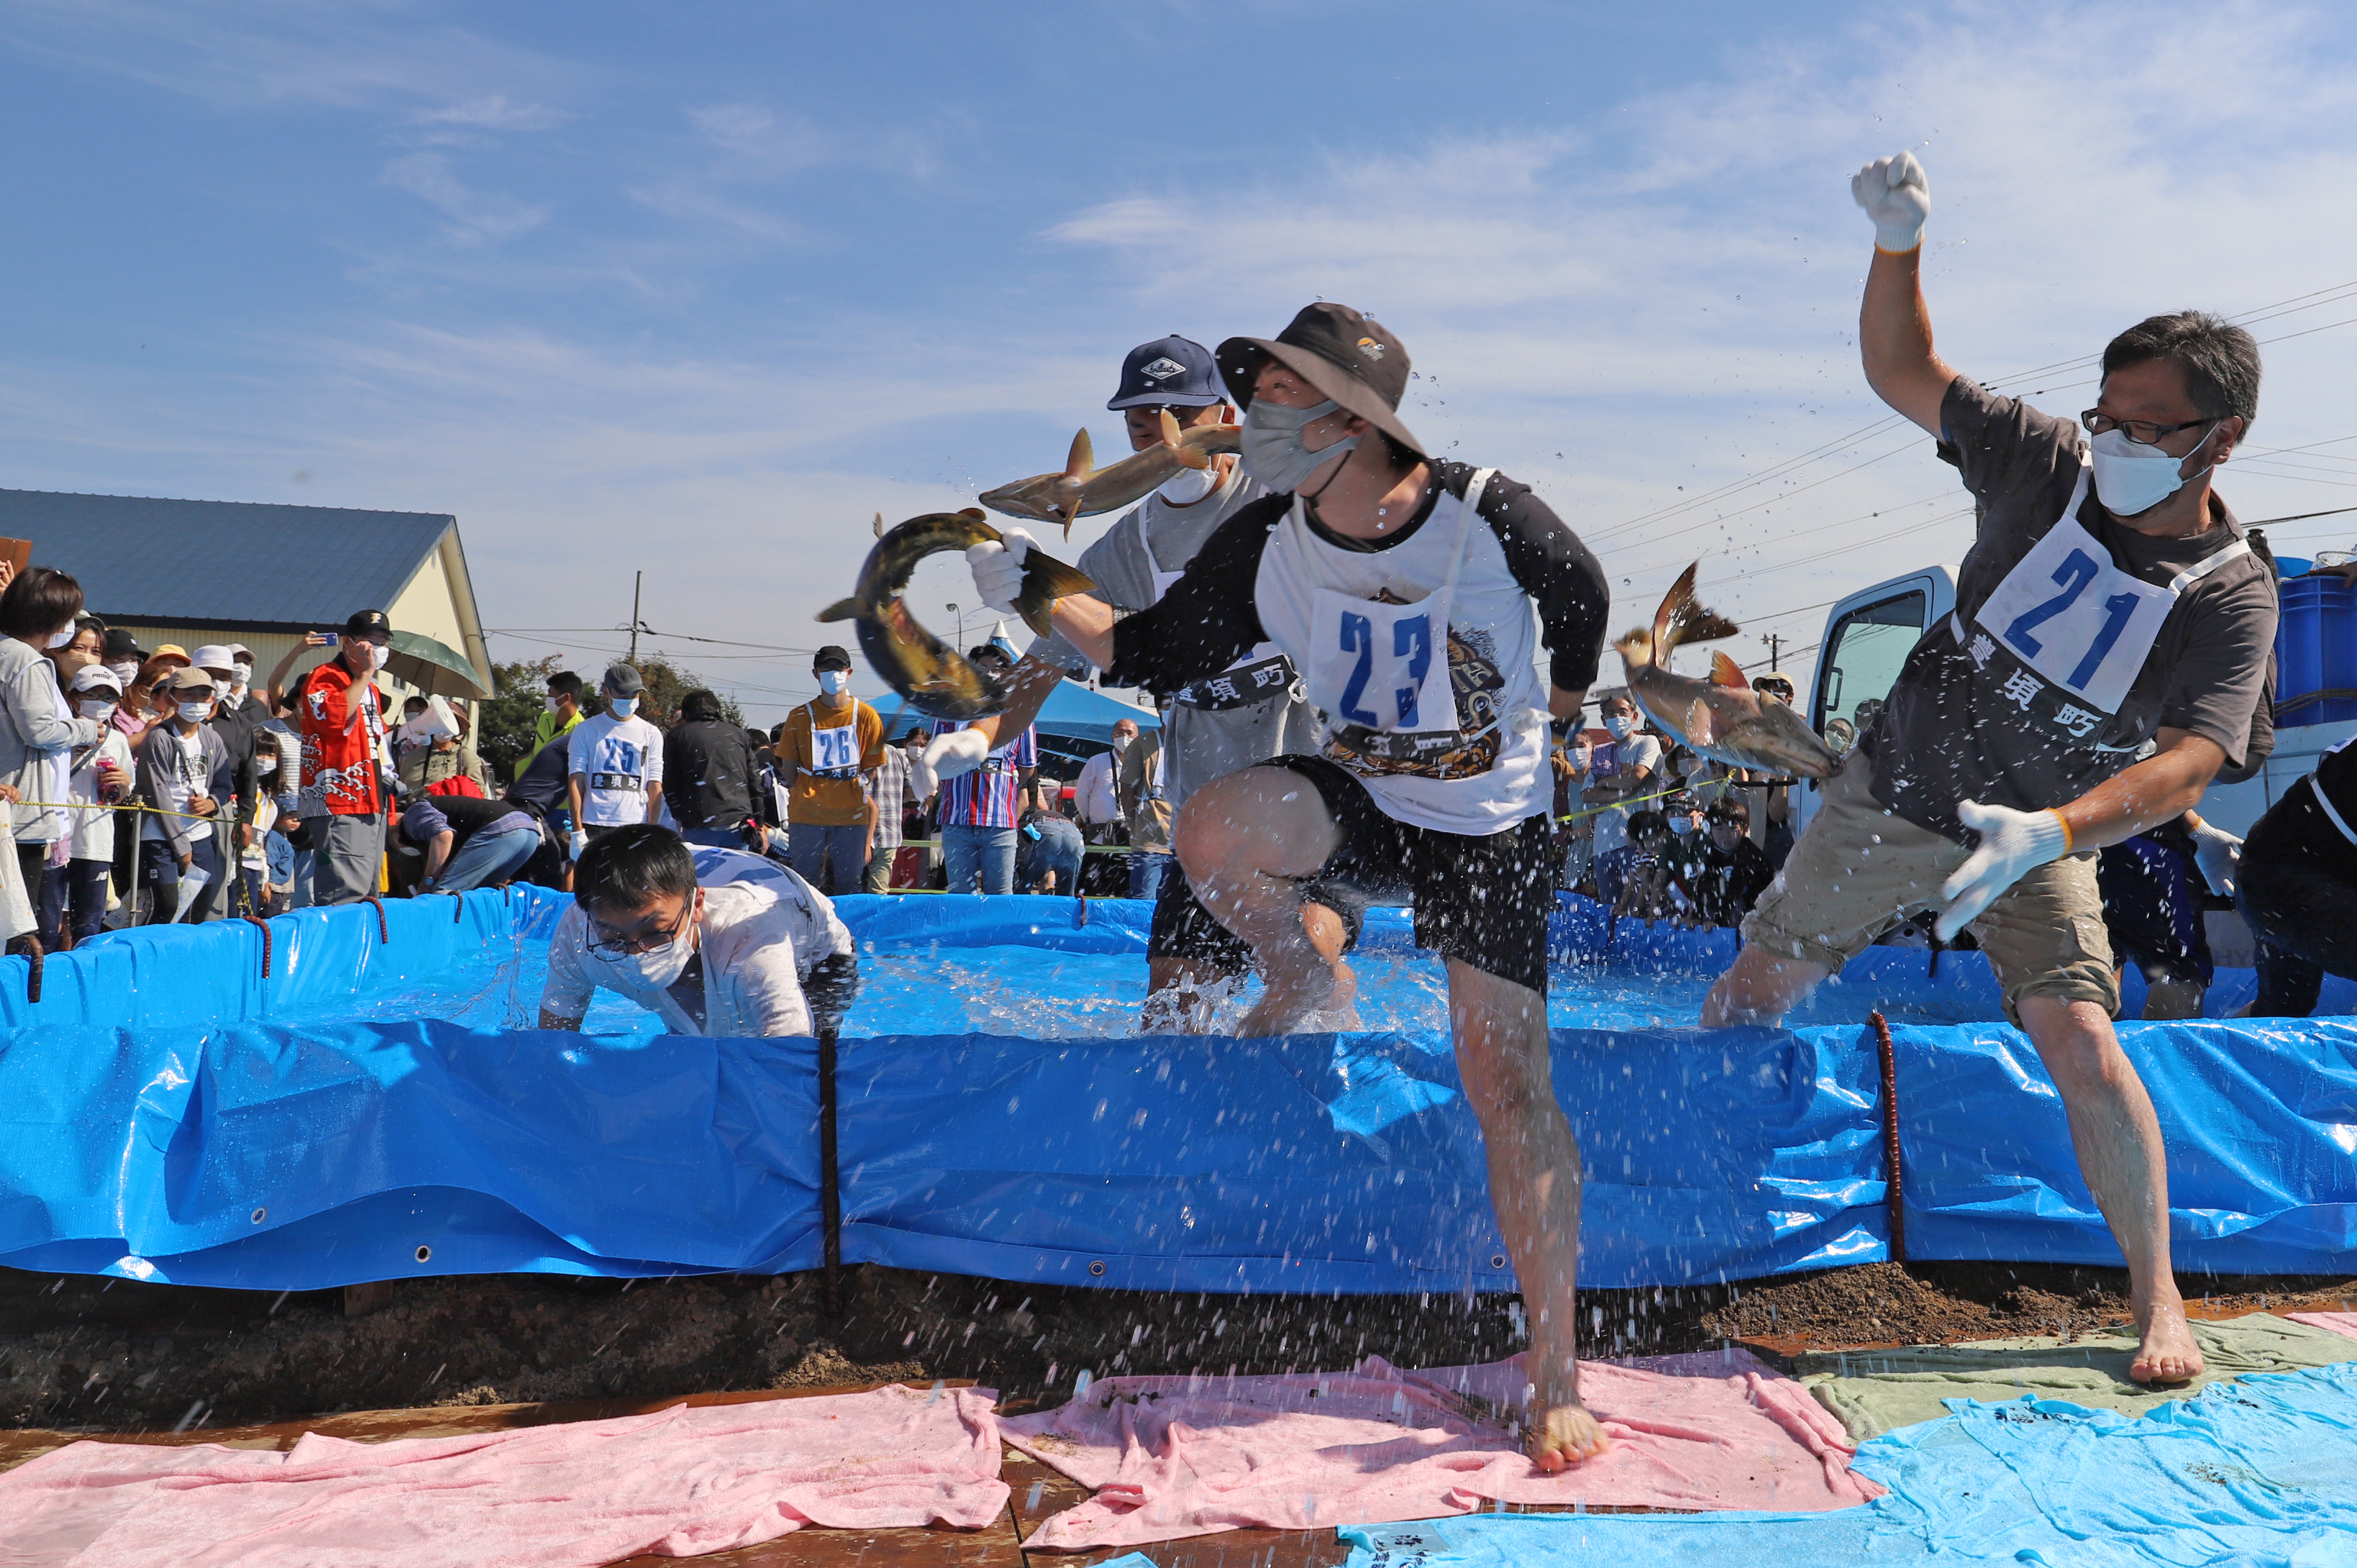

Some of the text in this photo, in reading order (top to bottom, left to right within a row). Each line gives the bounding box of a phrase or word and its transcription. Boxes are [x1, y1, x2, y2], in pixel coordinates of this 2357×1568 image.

[2003, 548, 2141, 691] 21
[1339, 610, 1431, 728] 23
[1968, 634, 2102, 737] 豊頃町
[593, 775, 639, 789] 豊頃町
[603, 738, 634, 773] 25
[820, 731, 850, 767] 26
